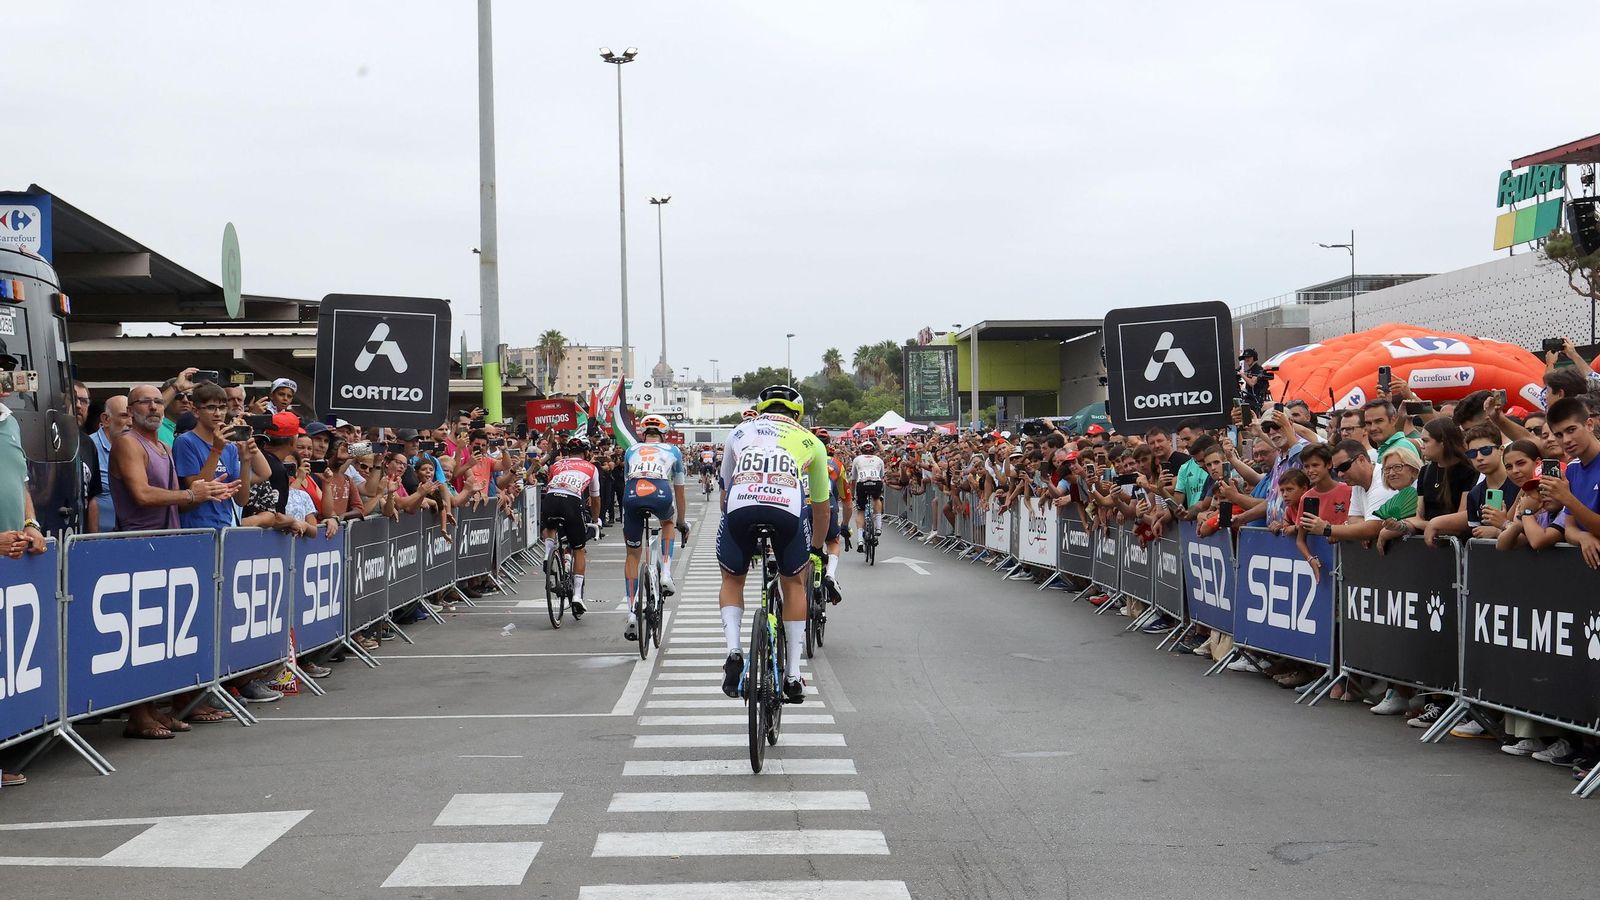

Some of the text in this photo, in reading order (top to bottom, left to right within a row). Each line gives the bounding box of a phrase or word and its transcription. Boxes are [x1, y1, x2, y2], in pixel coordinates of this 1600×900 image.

[340, 384, 423, 402] CORTIZO
[1412, 373, 1452, 382] Carrefour
[1133, 390, 1213, 409] CORTIZO
[748, 484, 782, 495] Circus
[469, 528, 490, 546] CORTIZO
[364, 555, 385, 582] CORTIZO
[397, 544, 417, 569] CORTIZO
[302, 550, 341, 625] SER
[1188, 541, 1231, 611] SER
[231, 557, 284, 643] SER
[1246, 554, 1317, 635] SER
[1347, 585, 1418, 630] KELME
[91, 566, 200, 675] SER
[1474, 602, 1574, 657] KELME
